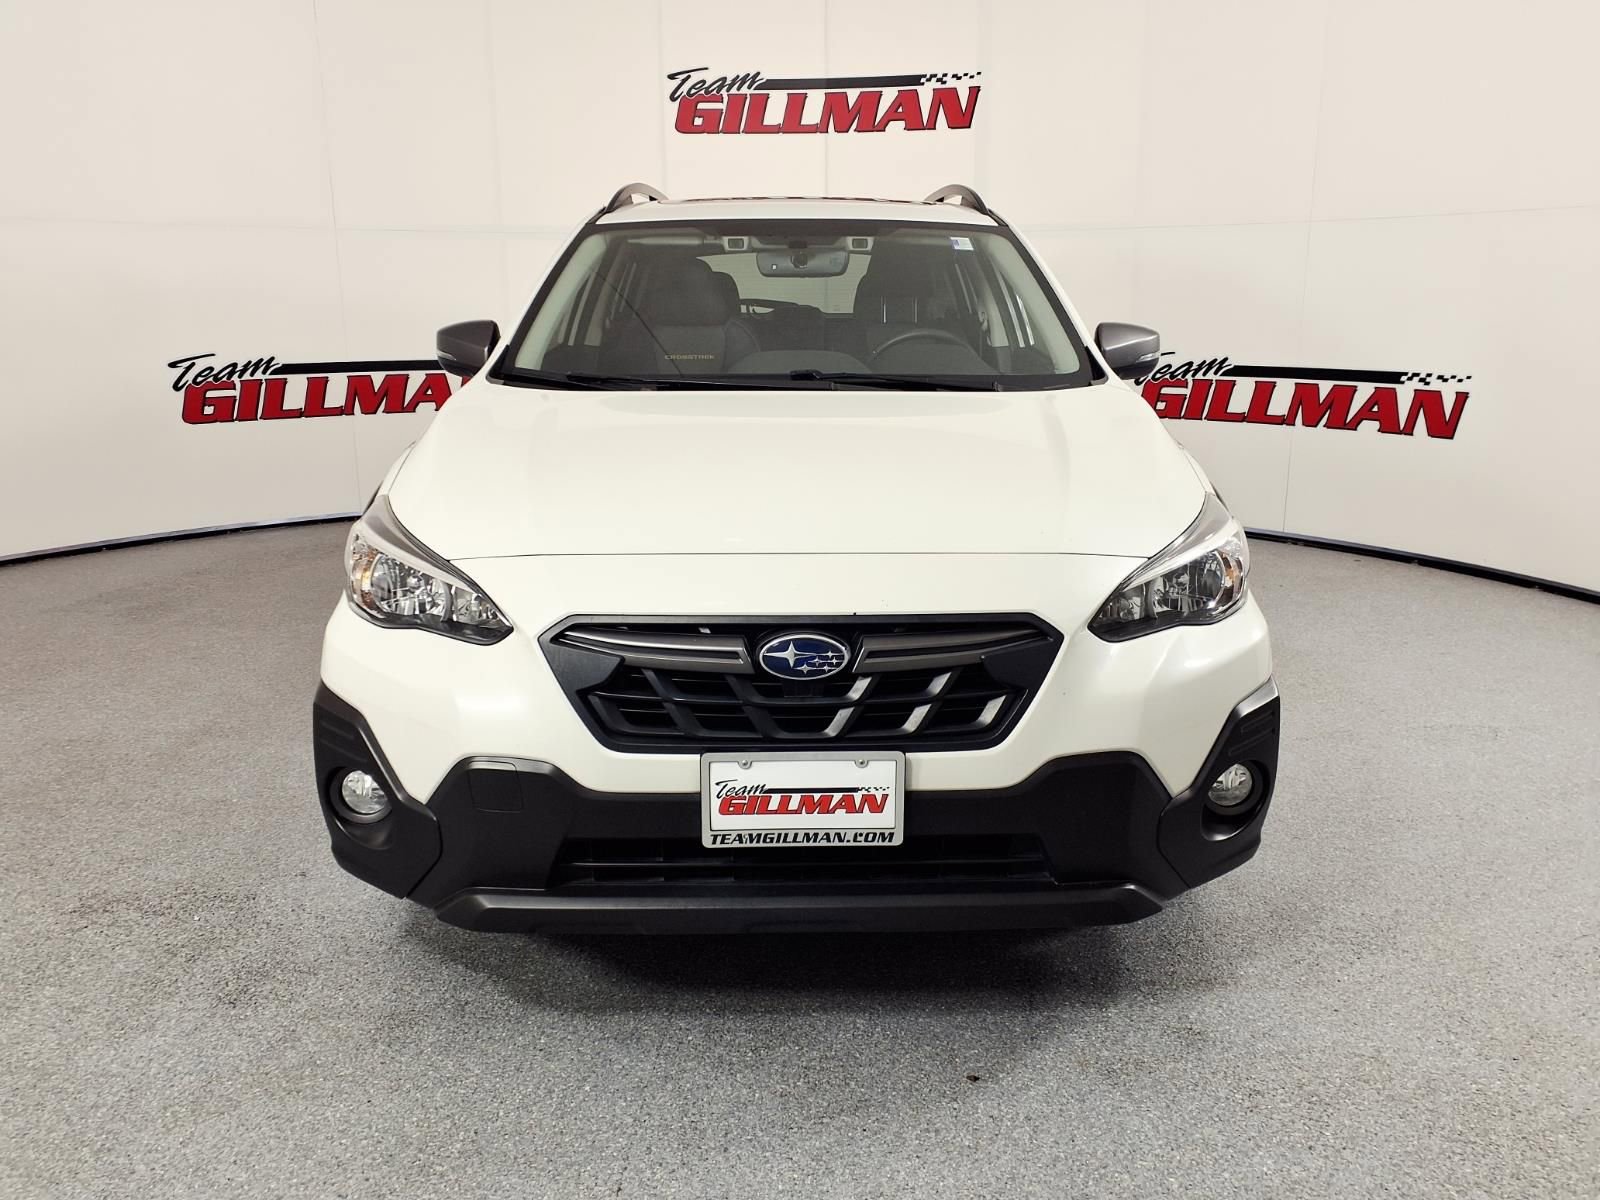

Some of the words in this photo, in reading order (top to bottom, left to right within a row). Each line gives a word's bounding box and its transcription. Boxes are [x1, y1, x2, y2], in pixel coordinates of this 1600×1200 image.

[667, 67, 763, 102] Team
[675, 86, 981, 134] GILLMAN
[167, 353, 279, 392] Team
[182, 373, 473, 424] GILLMA
[1141, 379, 1470, 440] GILLMAN
[715, 779, 766, 799] Team
[718, 794, 888, 815] GILLMAN
[710, 832, 895, 845] TEAMGILLMAN.COM
